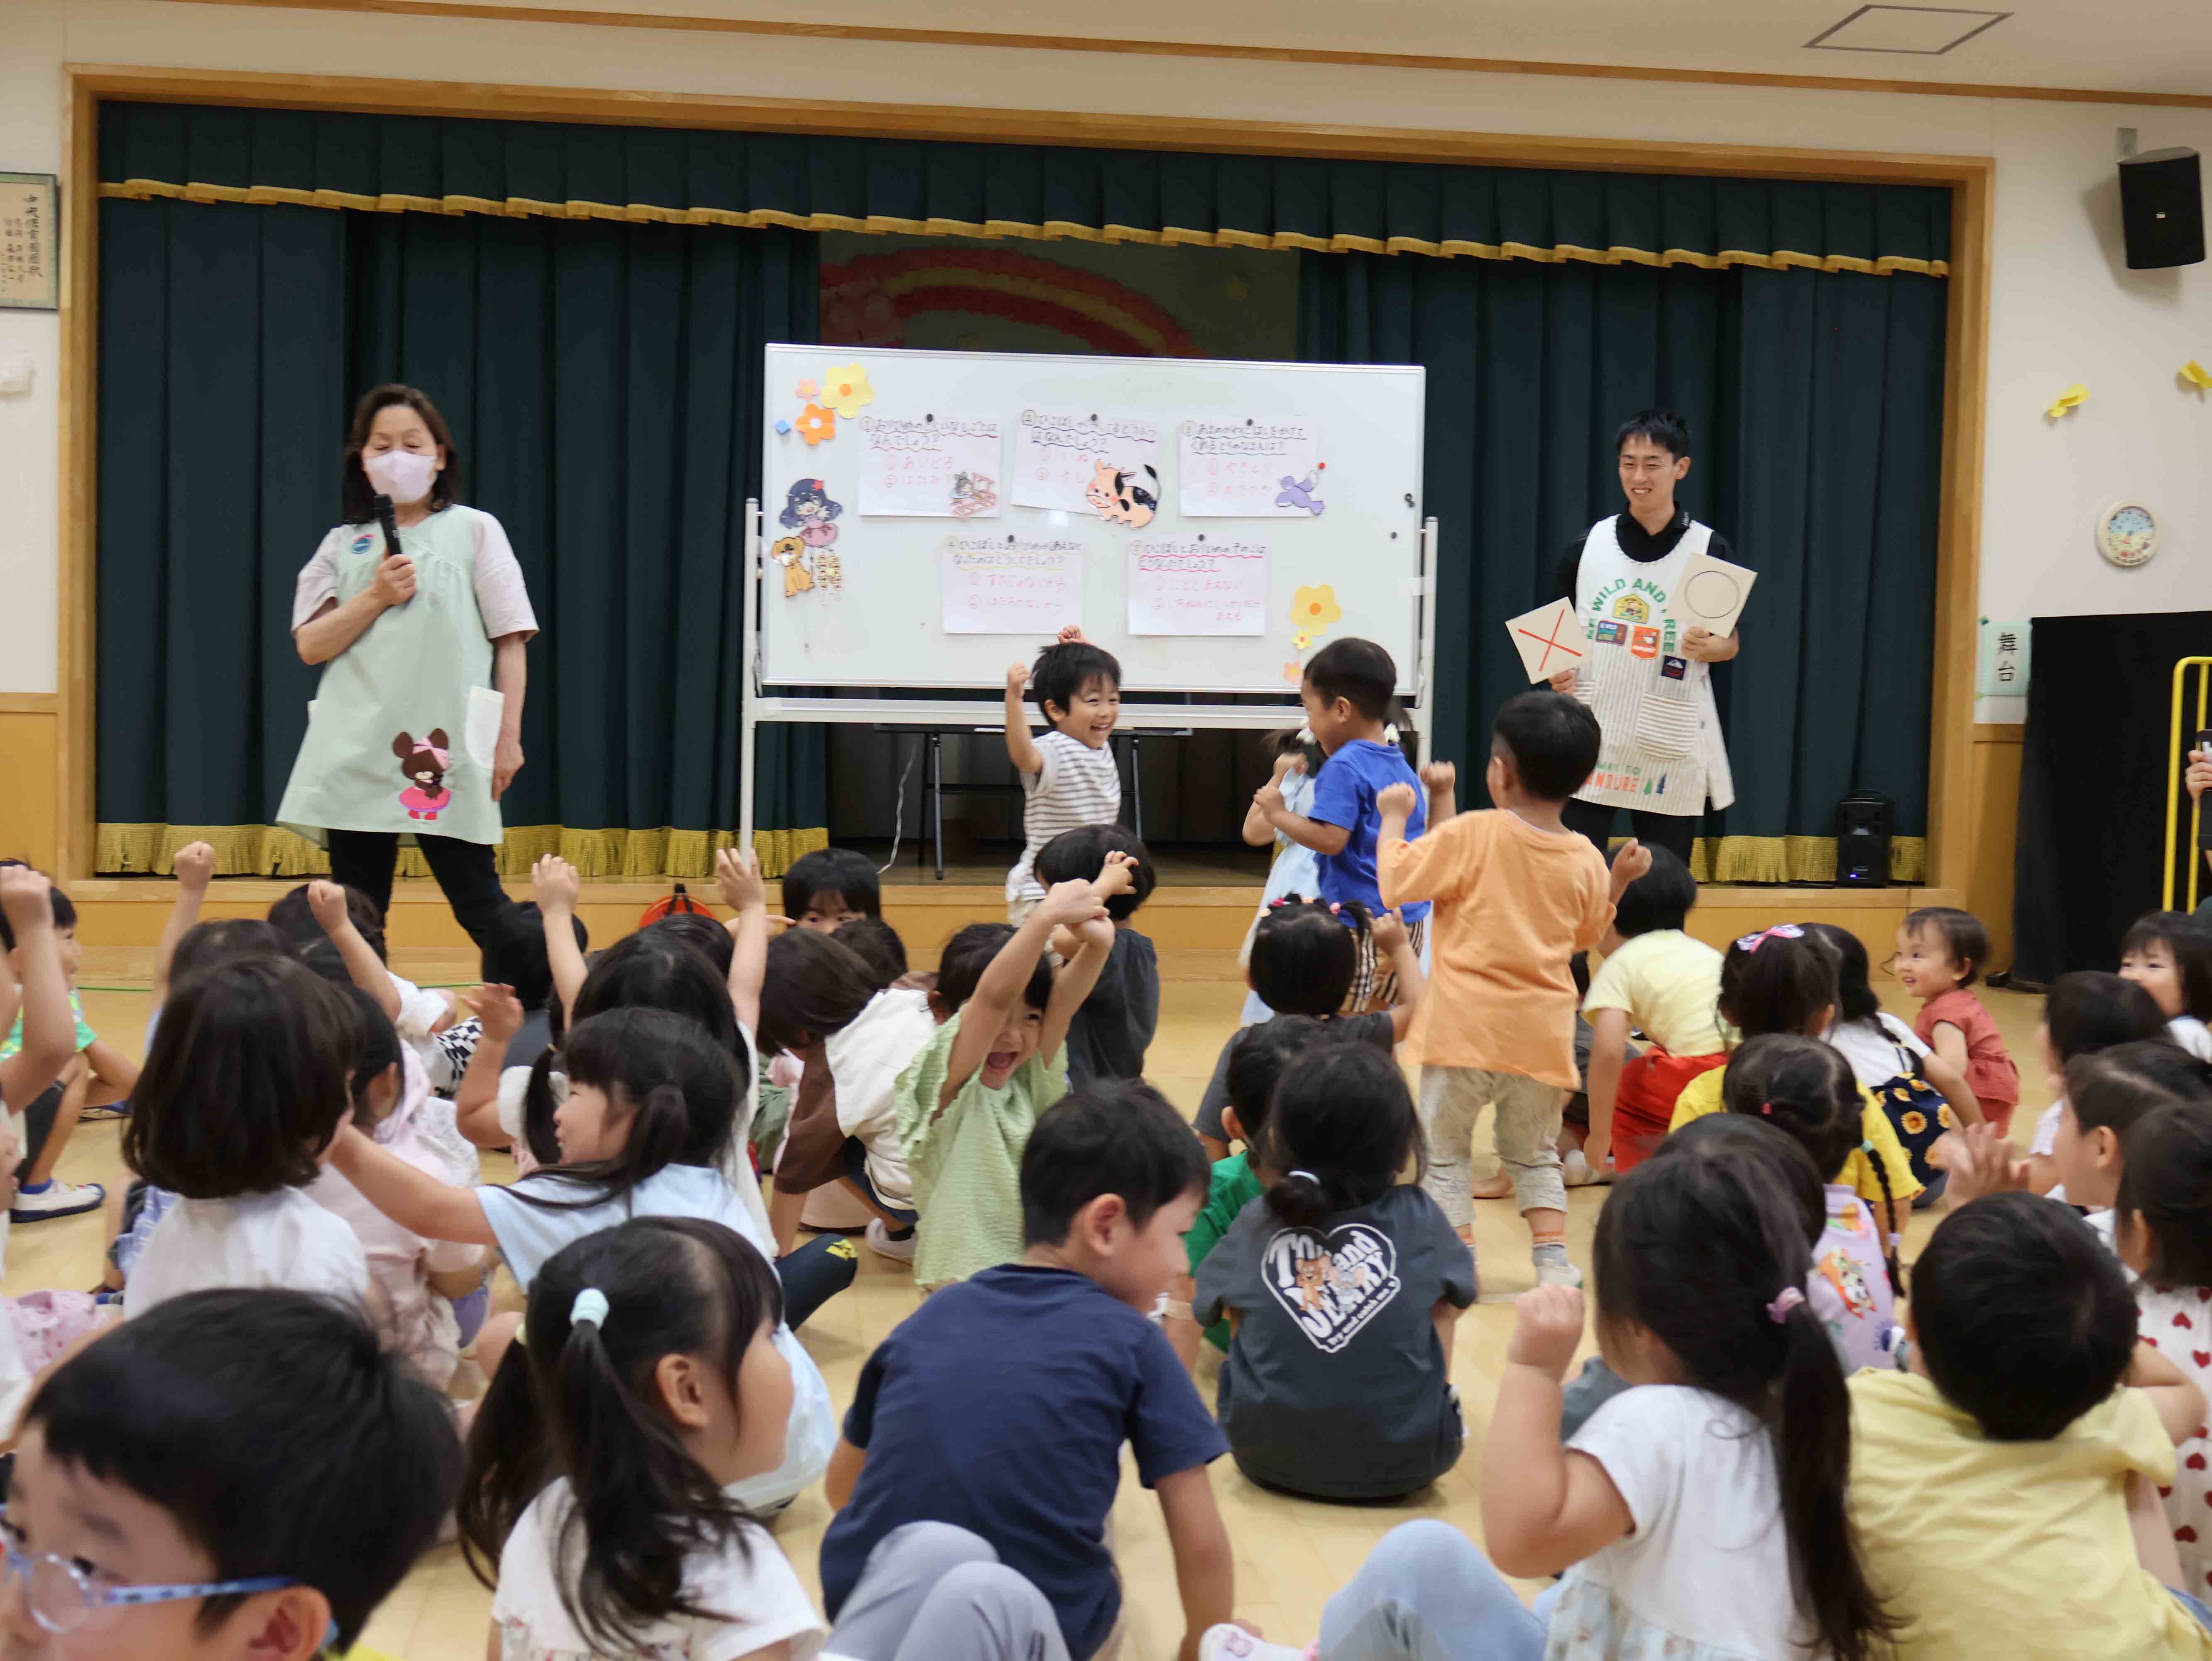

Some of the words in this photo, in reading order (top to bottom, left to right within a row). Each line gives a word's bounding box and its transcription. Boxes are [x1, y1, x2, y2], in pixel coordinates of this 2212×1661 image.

[1592, 578, 1626, 611] WILD
[1632, 578, 1666, 603] AND
[1996, 632, 2019, 681] 舞台
